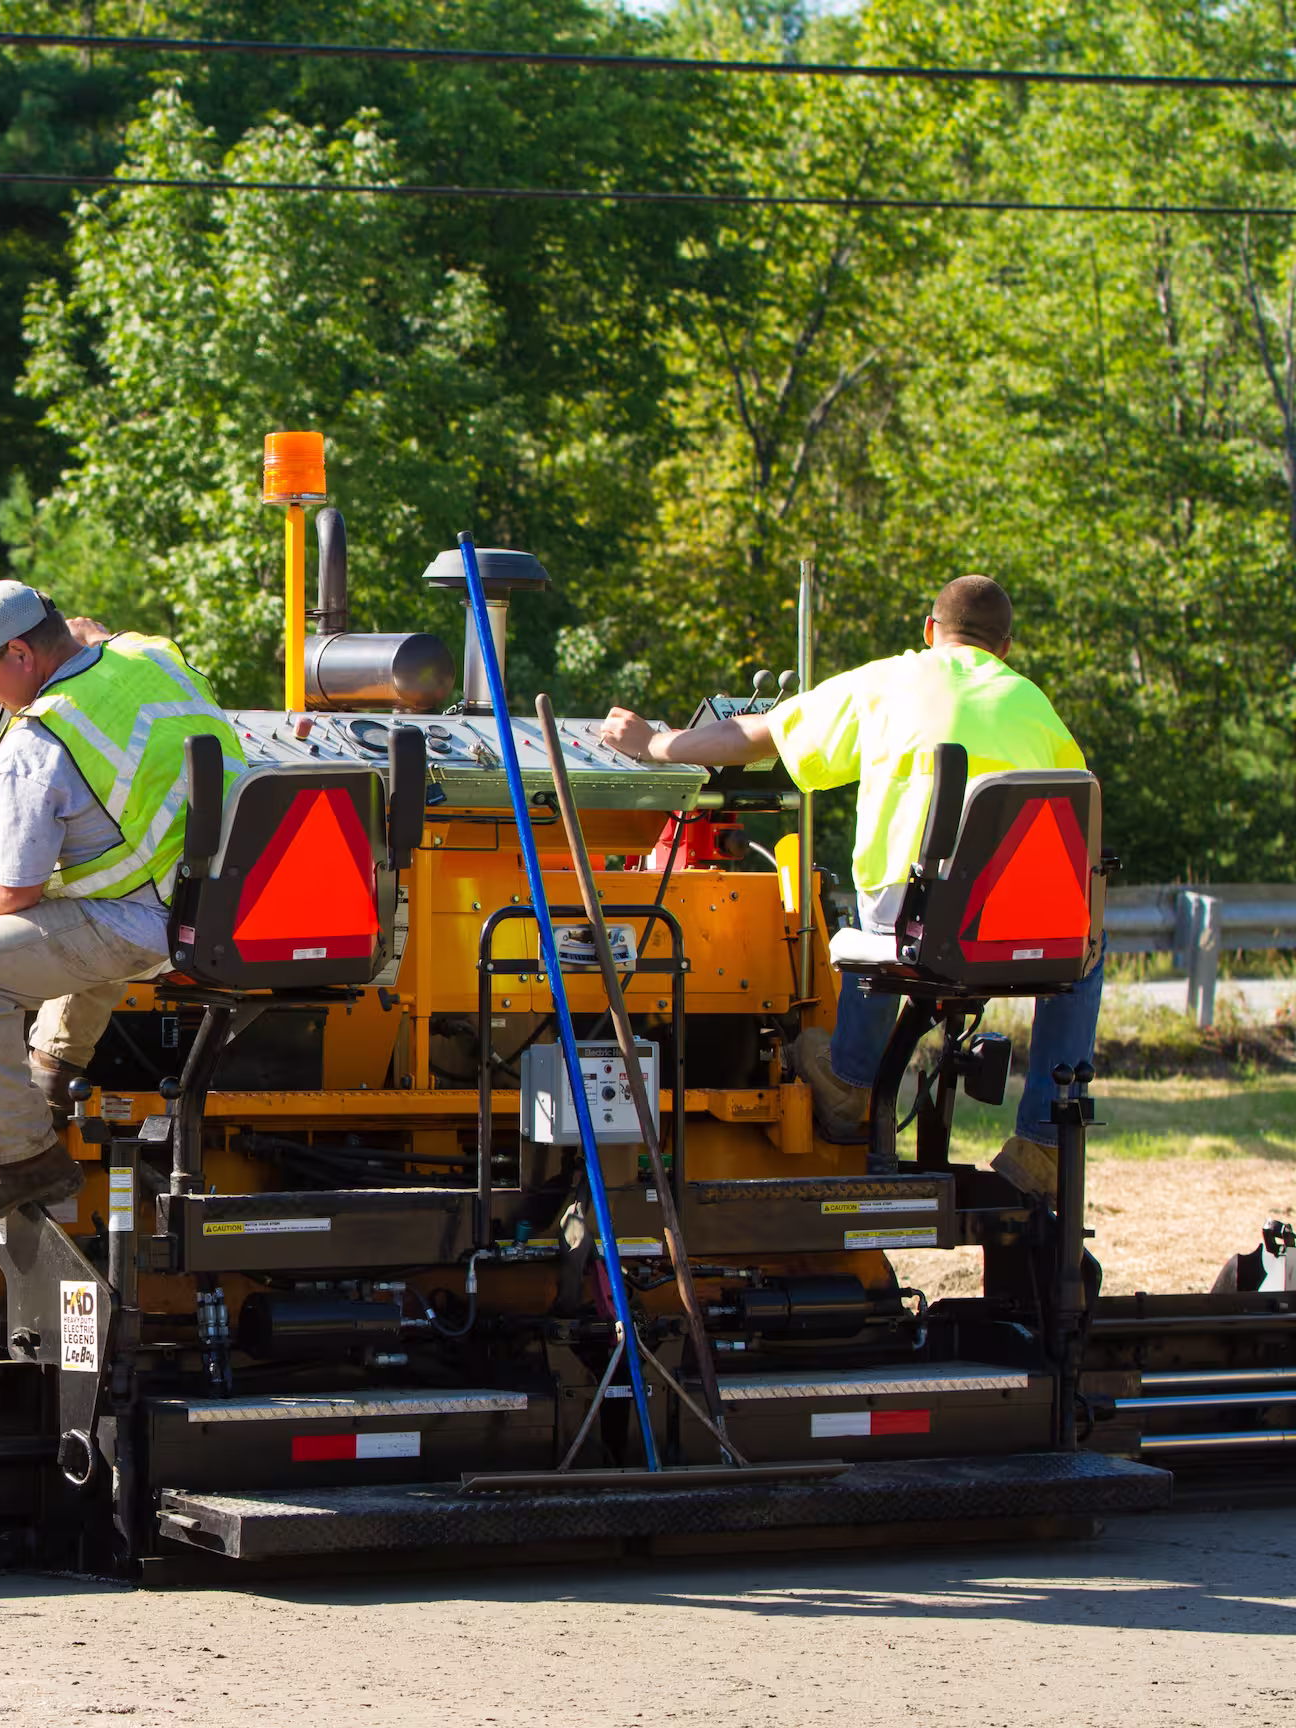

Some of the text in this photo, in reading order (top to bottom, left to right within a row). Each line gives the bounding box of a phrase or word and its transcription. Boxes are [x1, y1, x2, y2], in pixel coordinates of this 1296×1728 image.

[585, 1048, 612, 1057] Electric
[213, 1224, 242, 1232] CAUTION
[64, 1325, 94, 1333] ELECTRIC
[64, 1334, 94, 1344] LEGEND
[65, 1346, 94, 1368] LeeBoy
